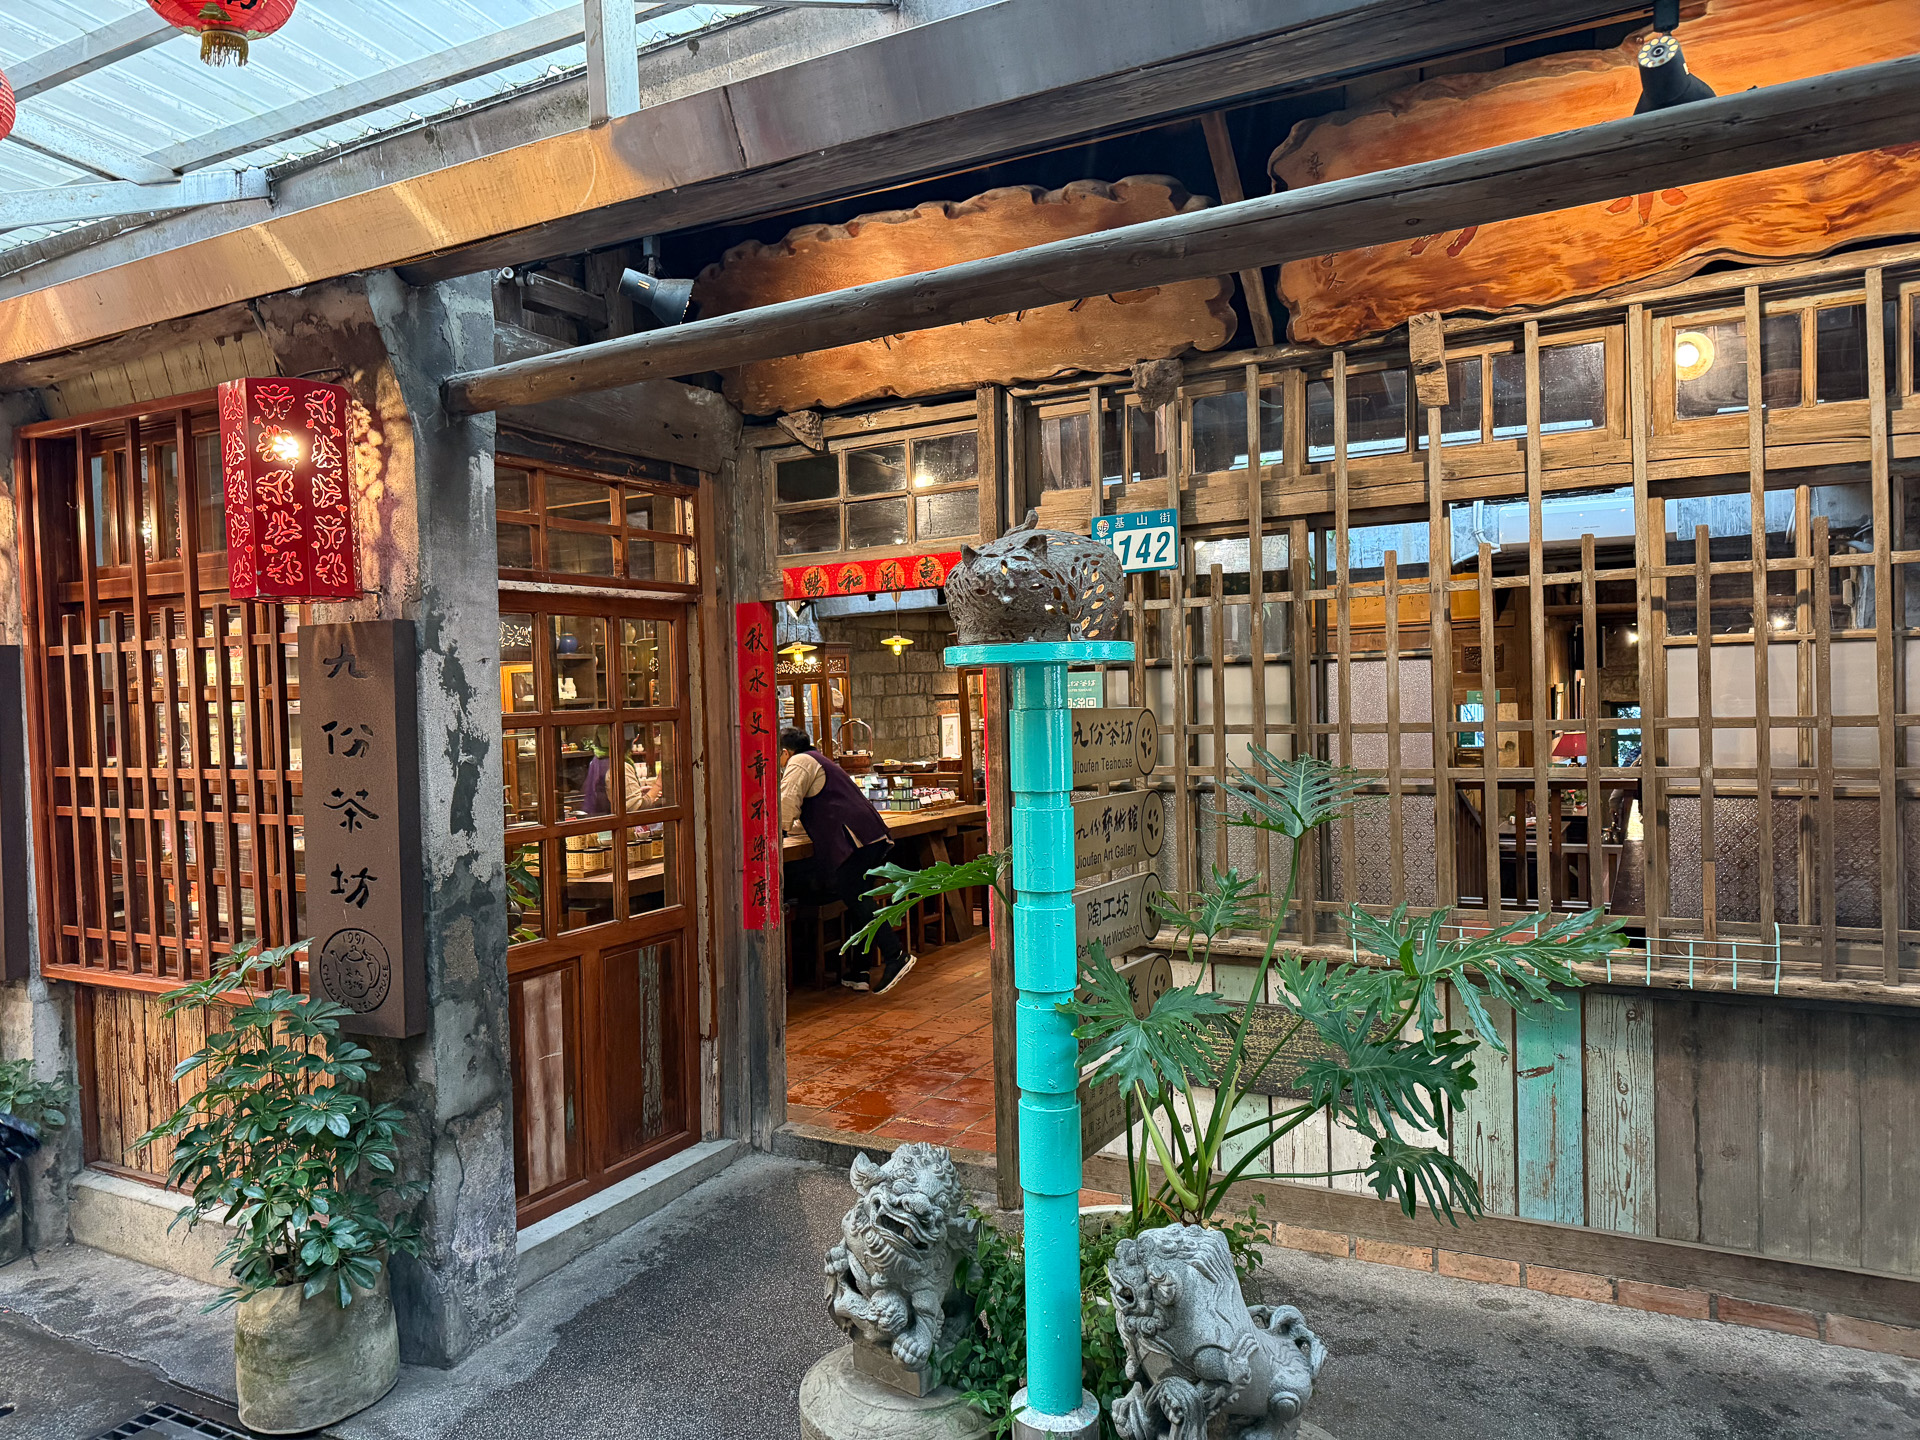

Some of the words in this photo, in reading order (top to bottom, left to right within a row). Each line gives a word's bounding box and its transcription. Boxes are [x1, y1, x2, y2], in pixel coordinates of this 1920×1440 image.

[1115, 512, 1171, 529] 基山街
[1119, 531, 1171, 566] 142
[1073, 719, 1134, 748] 九份茶坊
[320, 643, 379, 909] 九份茶坊
[1101, 757, 1133, 771] Teahouse
[1076, 851, 1102, 870] Jioufen
[1103, 848, 1114, 862] Art
[1114, 842, 1138, 859] Gallery
[1086, 889, 1130, 930] 陶工坊
[343, 932, 366, 945] 1991
[1102, 933, 1112, 947] Art
[1111, 923, 1140, 945] Workshop
